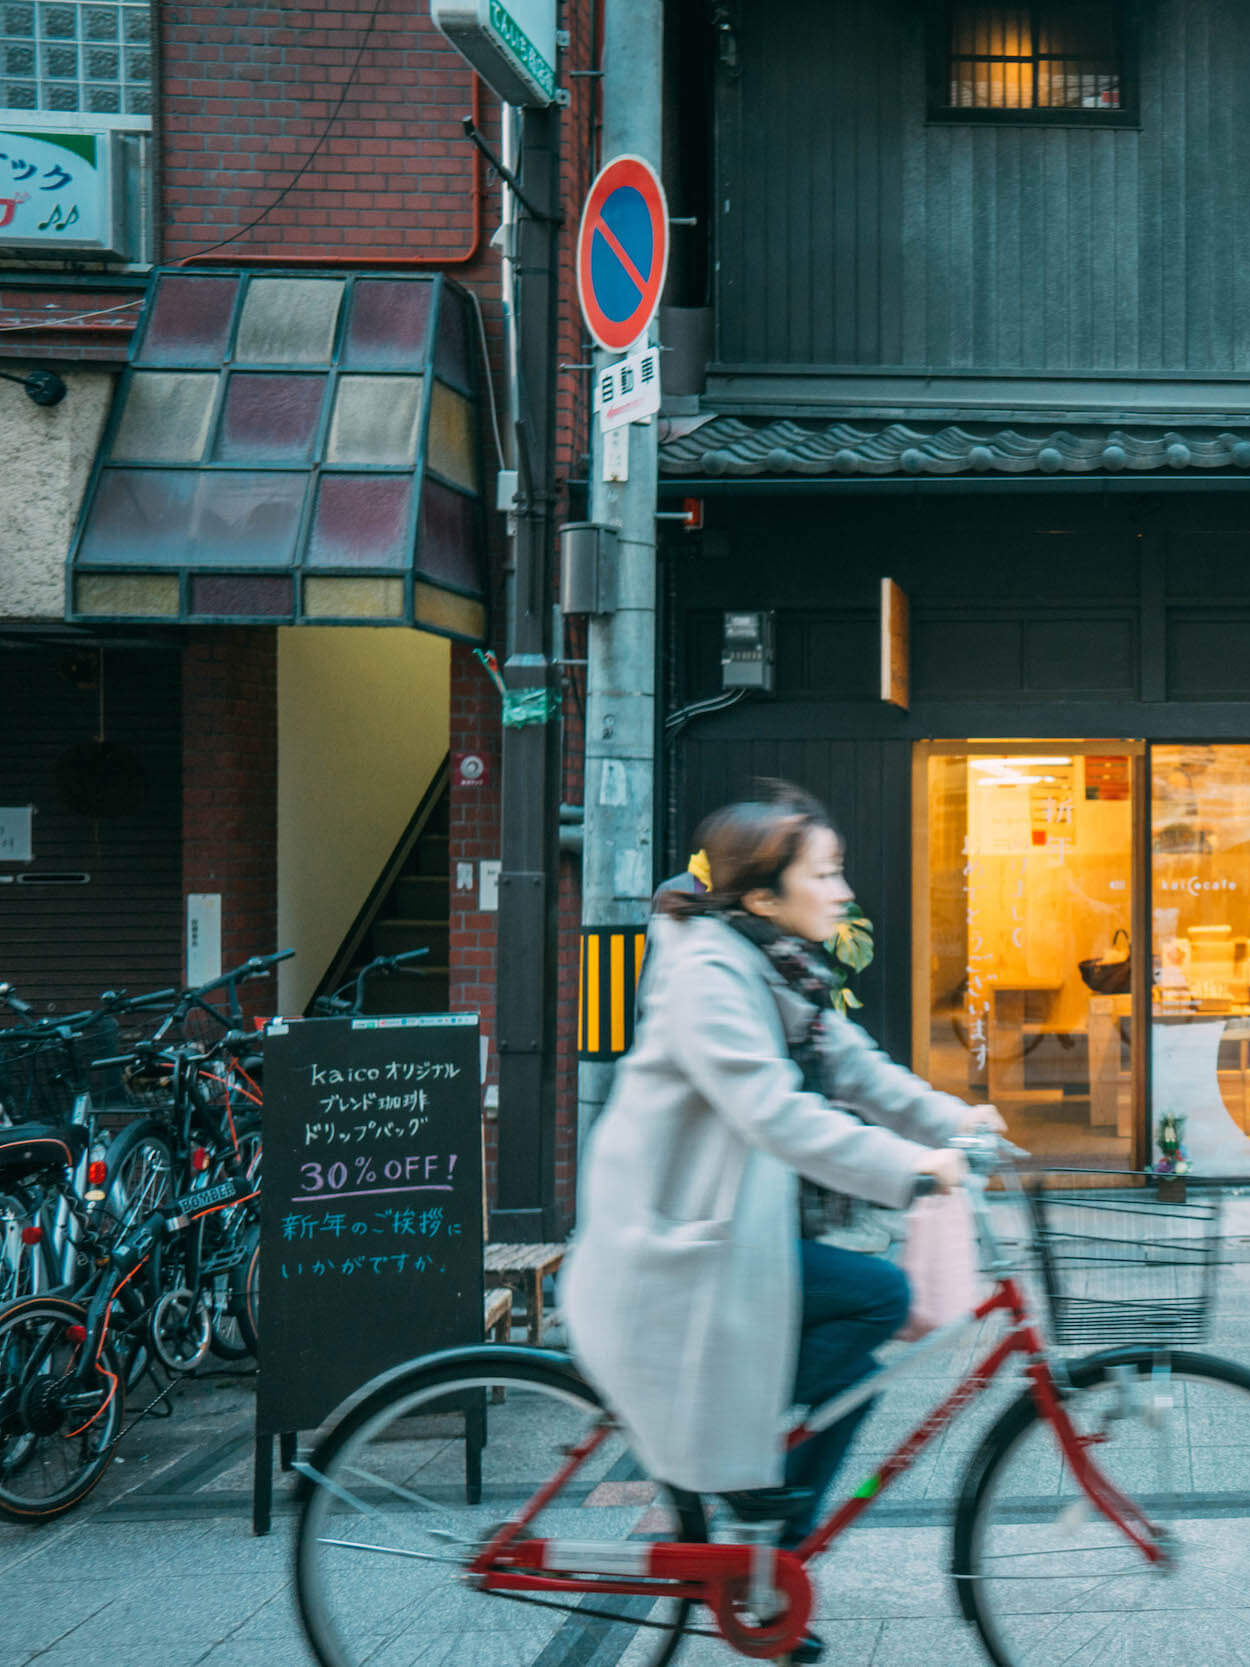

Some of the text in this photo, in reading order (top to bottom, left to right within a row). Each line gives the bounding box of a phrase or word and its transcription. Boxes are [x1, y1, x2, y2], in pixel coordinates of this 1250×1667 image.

[602, 356, 654, 403] 自動車
[305, 1117, 429, 1145] ドリップバッグ
[281, 1207, 462, 1240] 新年のご挨拶に
